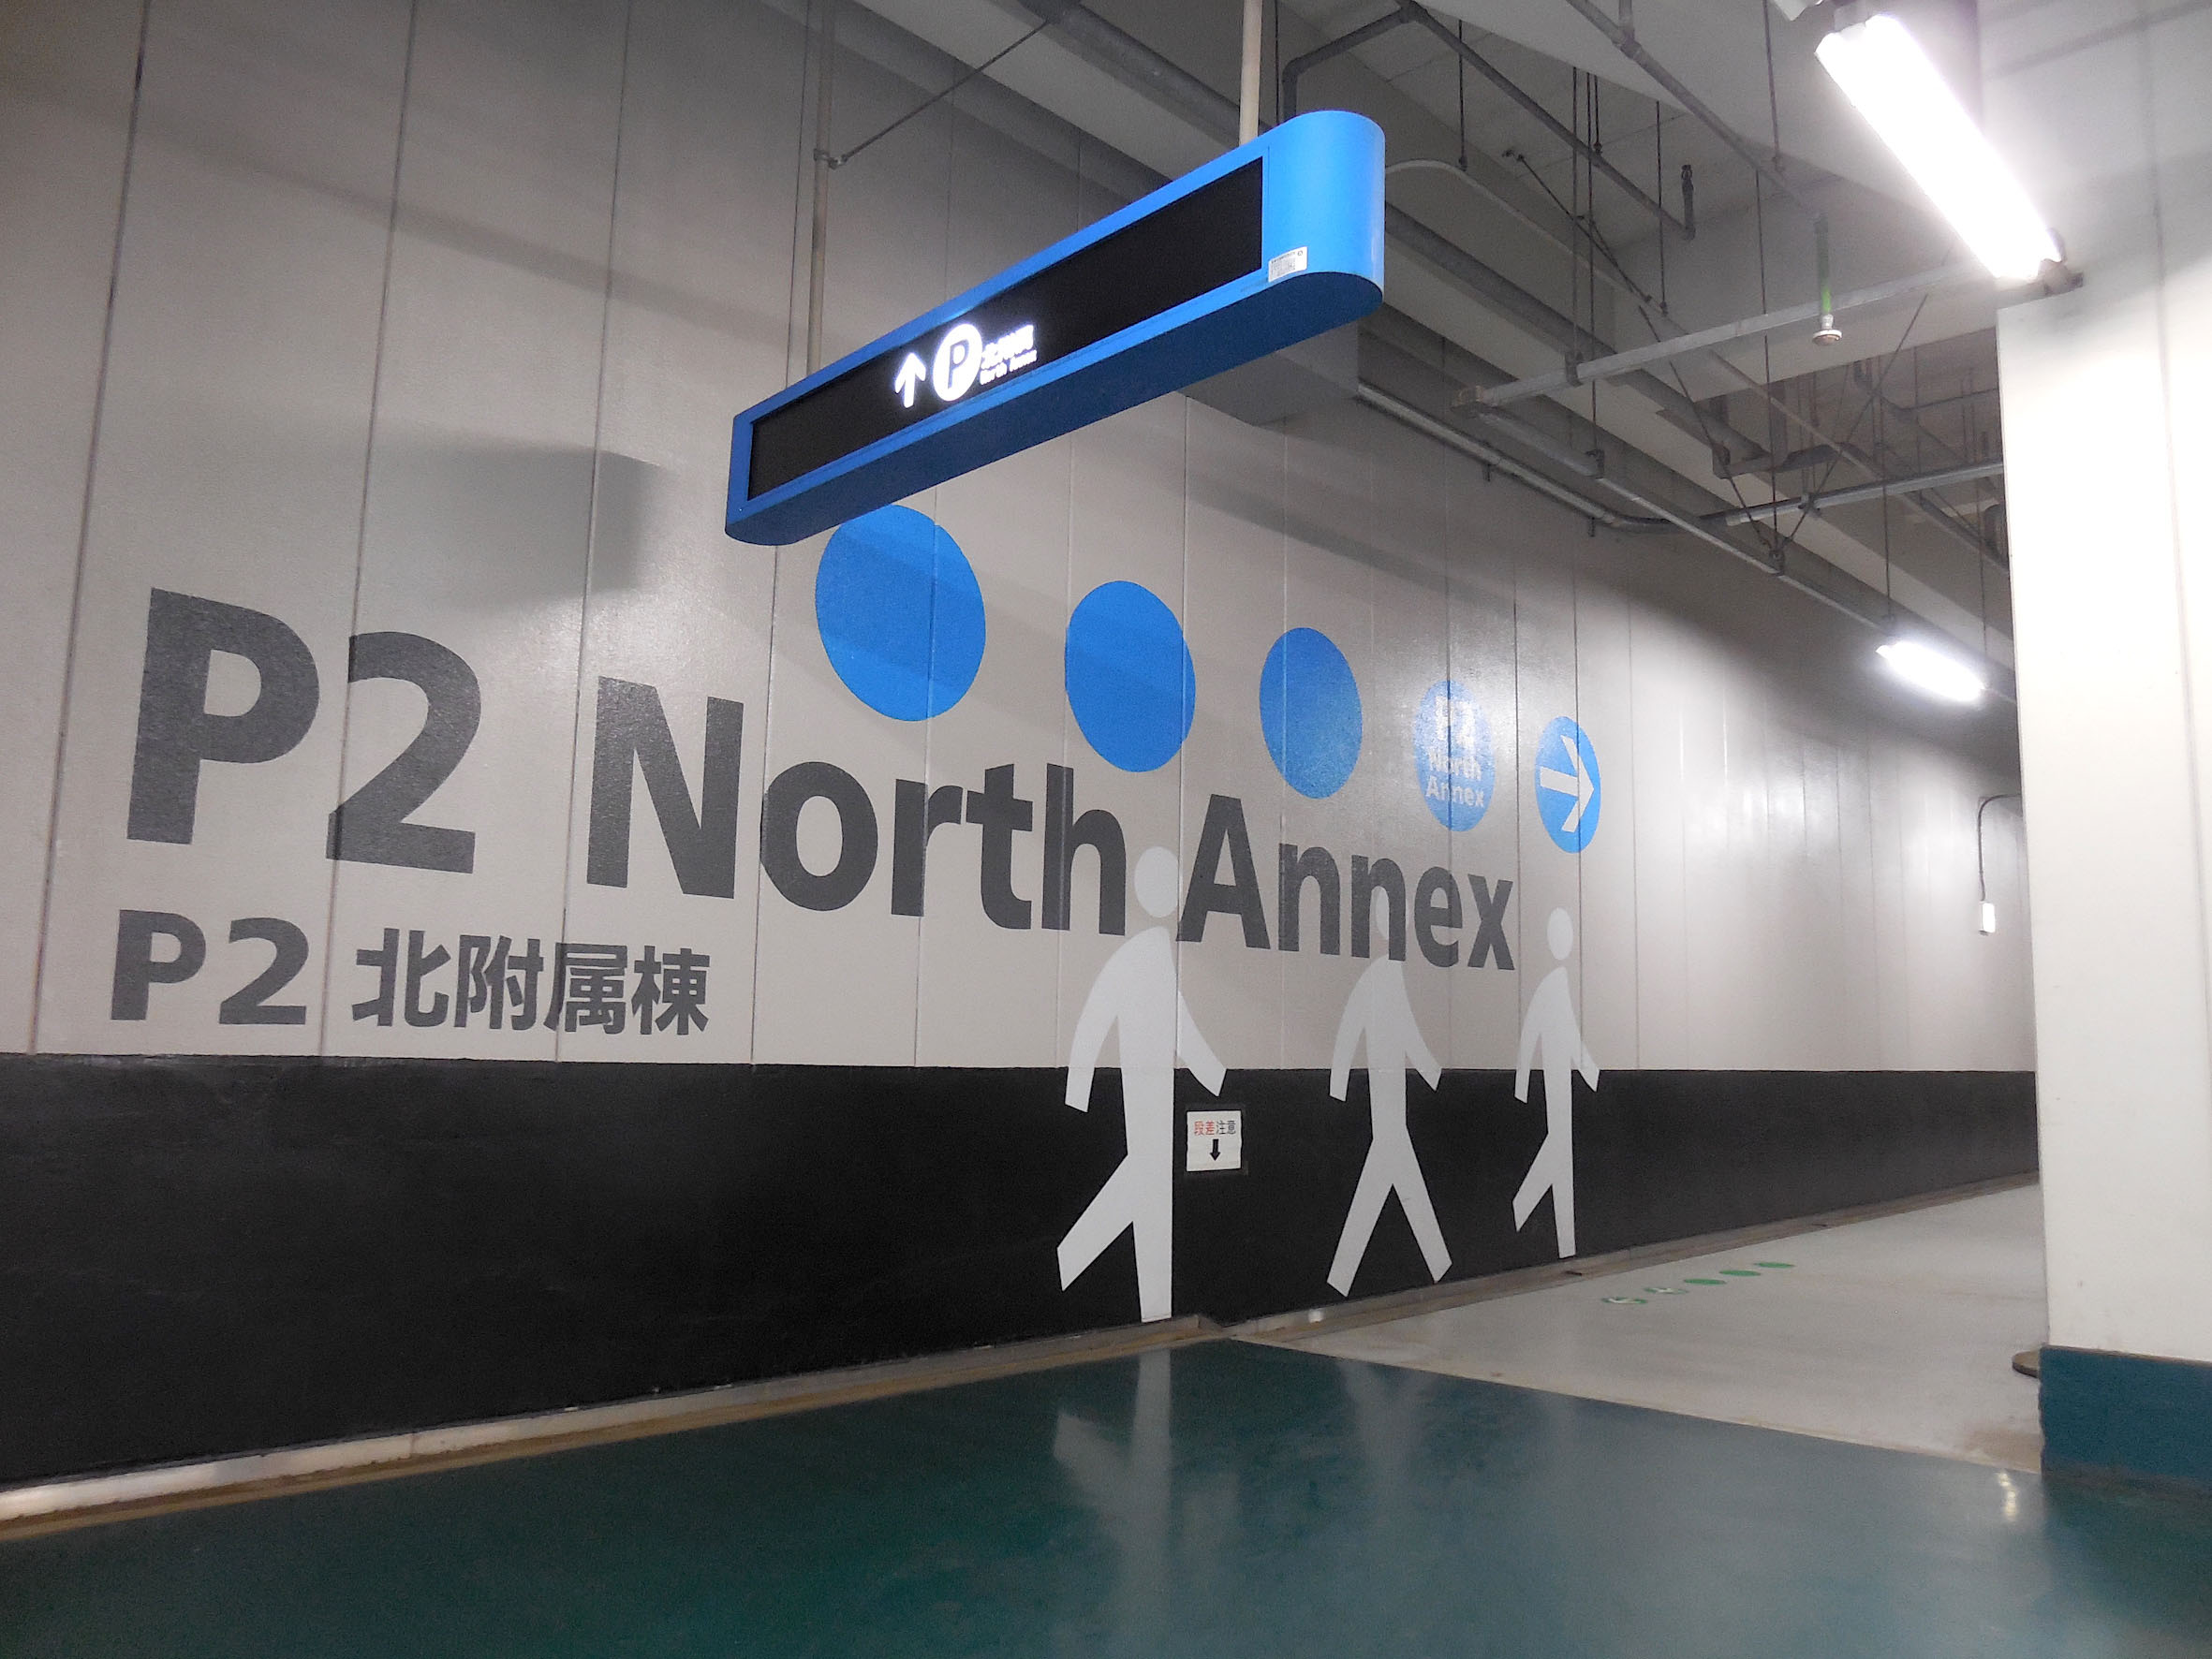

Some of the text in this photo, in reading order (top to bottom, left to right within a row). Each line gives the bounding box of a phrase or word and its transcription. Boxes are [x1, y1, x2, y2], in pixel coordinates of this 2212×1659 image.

[947, 339, 970, 390] P
[126, 586, 1515, 971] P2 North Annex
[1428, 748, 1482, 781] North
[1425, 775, 1484, 808] Annex
[110, 908, 711, 1036] P2 北附属棟
[1194, 1120, 1236, 1136] 段差注意
